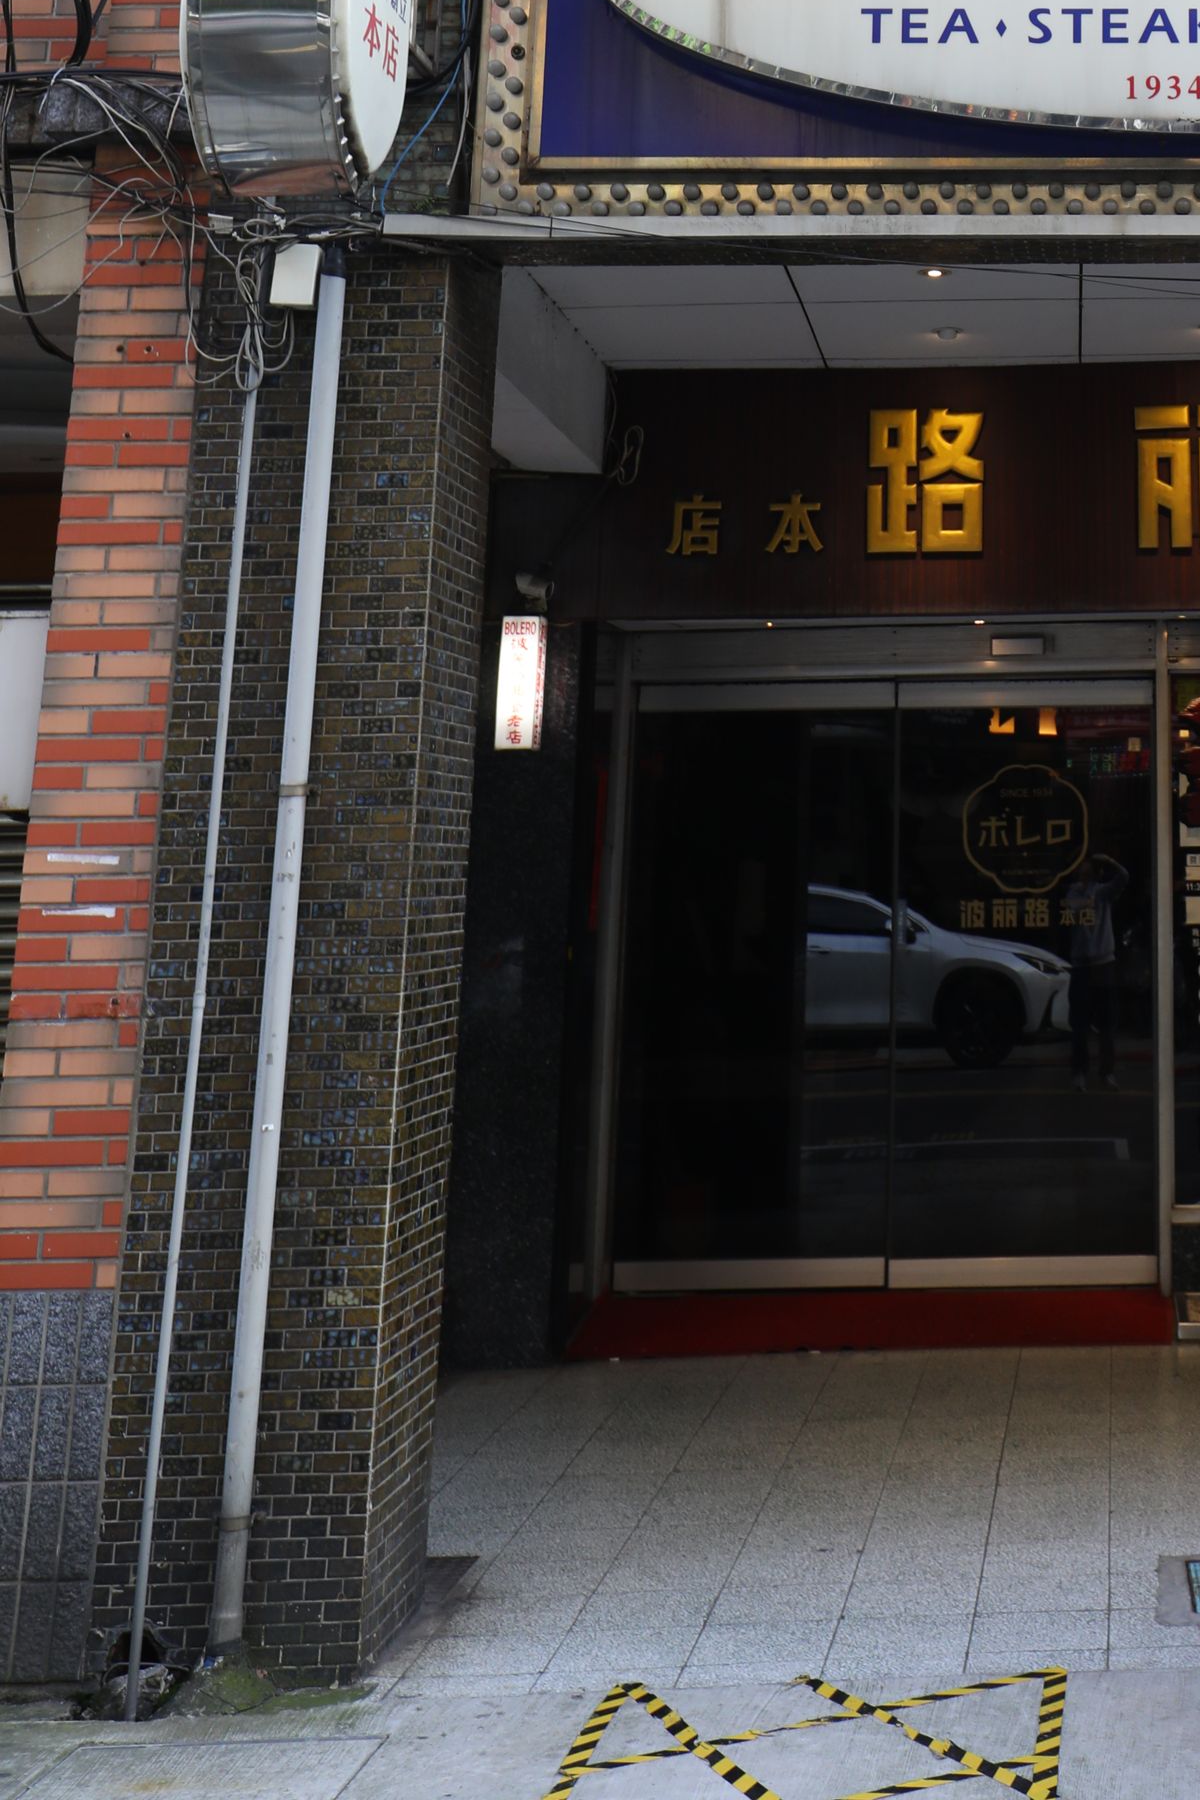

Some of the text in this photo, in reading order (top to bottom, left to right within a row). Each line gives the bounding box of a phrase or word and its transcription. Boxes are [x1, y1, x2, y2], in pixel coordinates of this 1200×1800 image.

[362, 2, 400, 84] 本店
[861, 7, 980, 45] TEA
[503, 620, 537, 636] BOLERO
